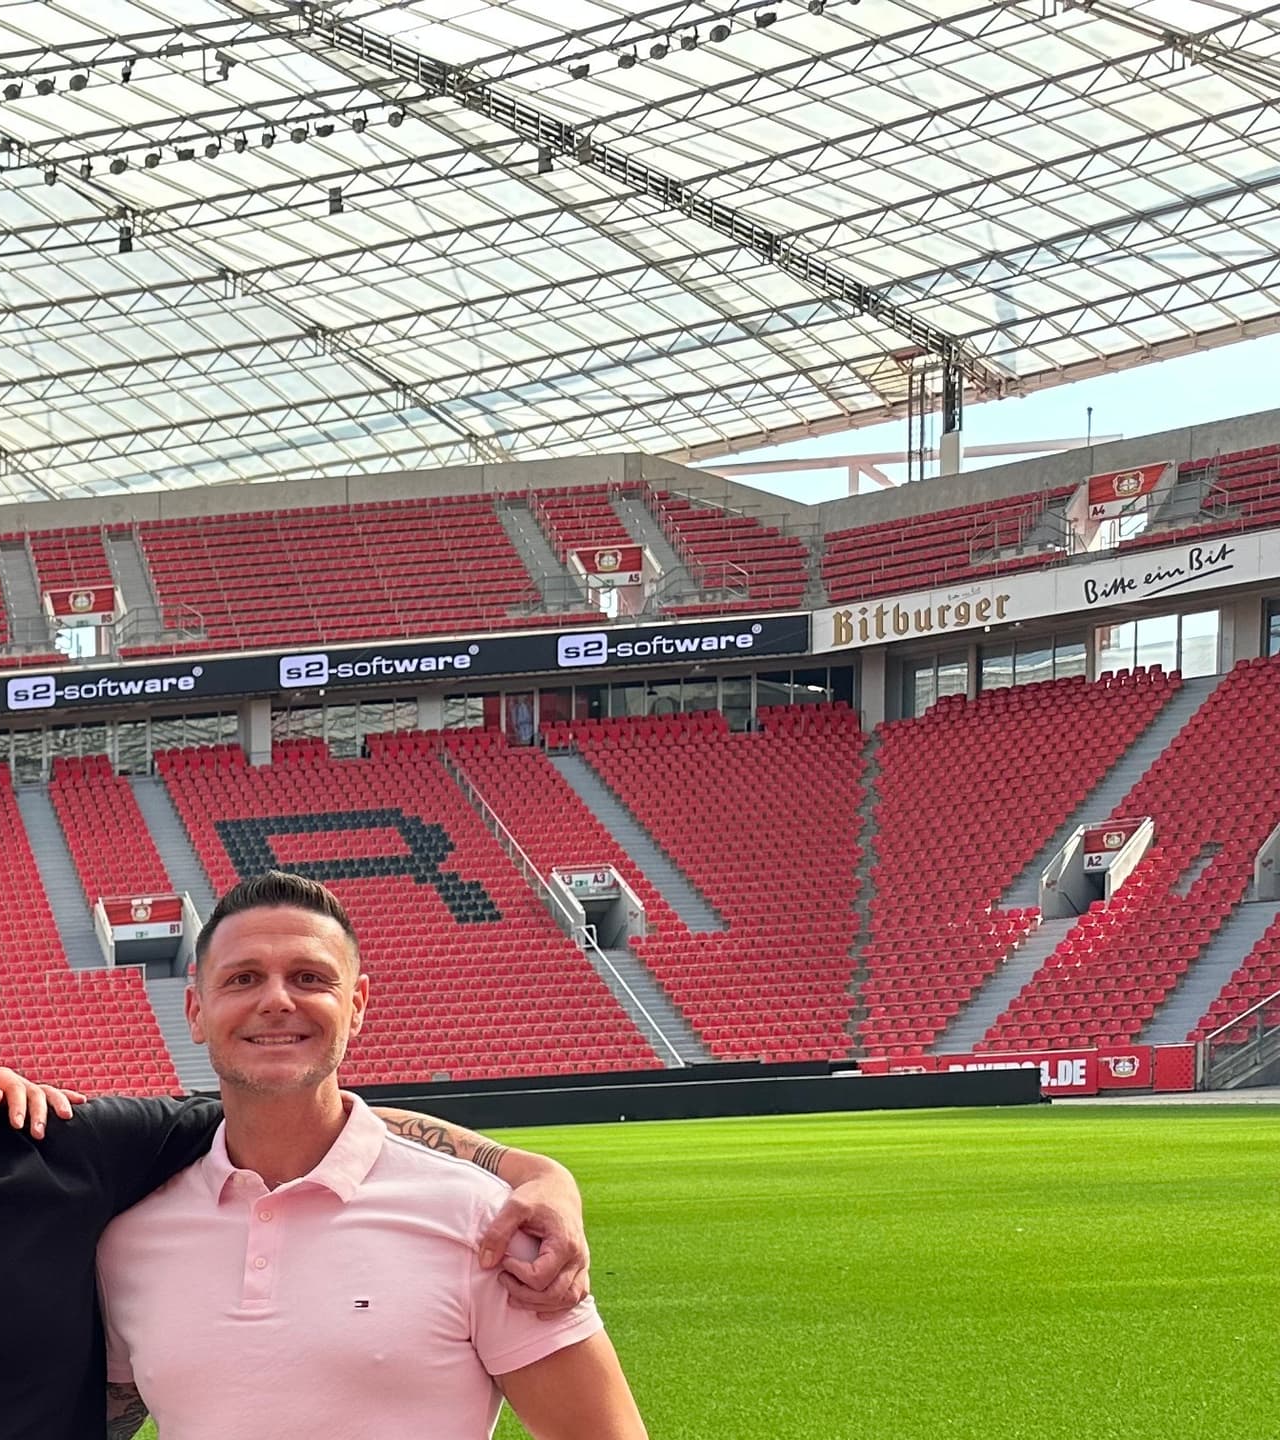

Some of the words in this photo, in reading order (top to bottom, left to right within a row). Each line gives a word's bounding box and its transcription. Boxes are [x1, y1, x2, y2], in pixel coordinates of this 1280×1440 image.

[1092, 506, 1105, 516] A4
[1084, 578, 1137, 604] Bitte
[1144, 566, 1184, 584] ein
[1190, 544, 1235, 570] Bit
[831, 594, 1010, 647] Bitburger
[1087, 856, 1102, 867] A2
[593, 874, 605, 883] A3
[169, 924, 181, 934] B1
